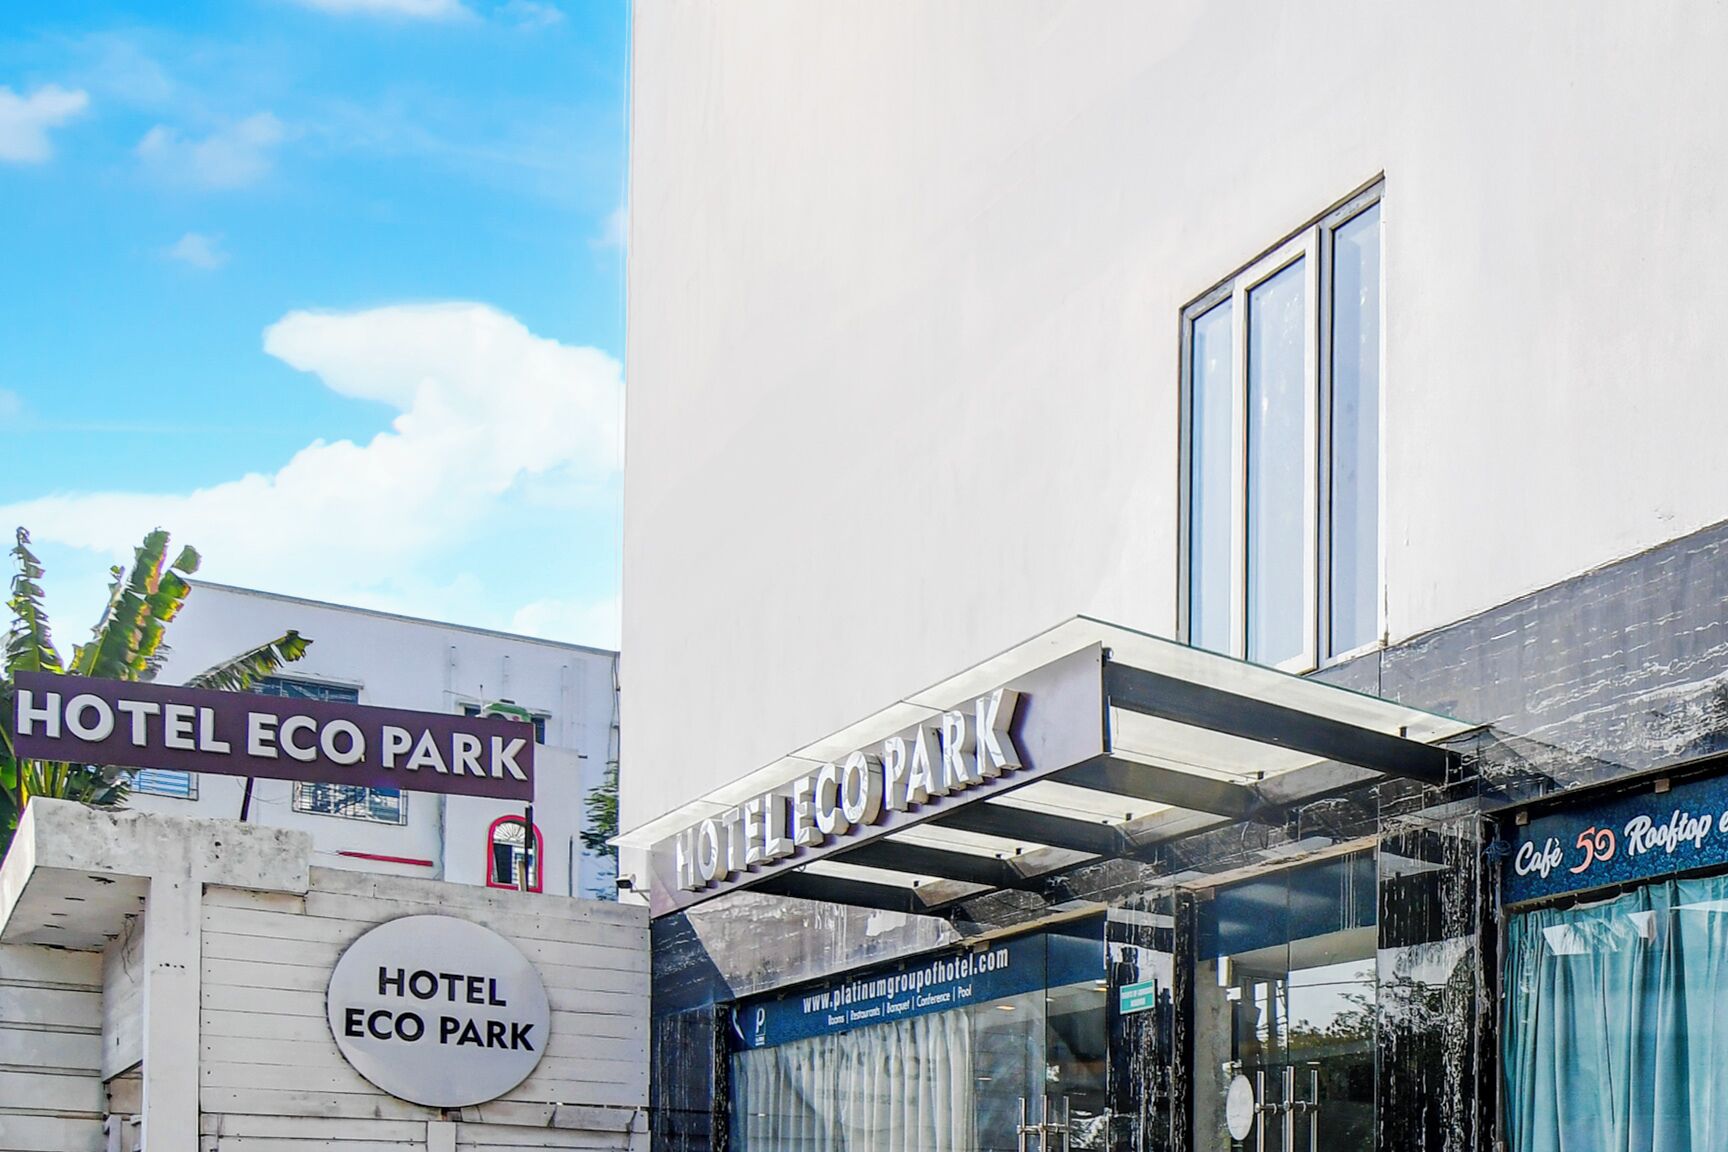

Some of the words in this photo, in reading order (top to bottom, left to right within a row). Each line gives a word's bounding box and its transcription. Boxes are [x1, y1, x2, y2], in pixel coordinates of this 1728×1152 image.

[17, 688, 231, 755] HOTEL
[248, 711, 366, 766] ECO
[381, 725, 529, 782] PARK
[676, 791, 795, 892] HOTEL
[793, 750, 886, 849] ECO
[883, 687, 1023, 813] PARK
[1624, 809, 1712, 856] Rooftop
[378, 966, 507, 1007] HOTEL
[803, 948, 1009, 1014] www.platinumgroupofhotel.com
[916, 992, 951, 1007] Conference
[957, 984, 972, 999] Pool
[345, 1007, 425, 1042] ECO
[440, 1015, 535, 1051] PARK
